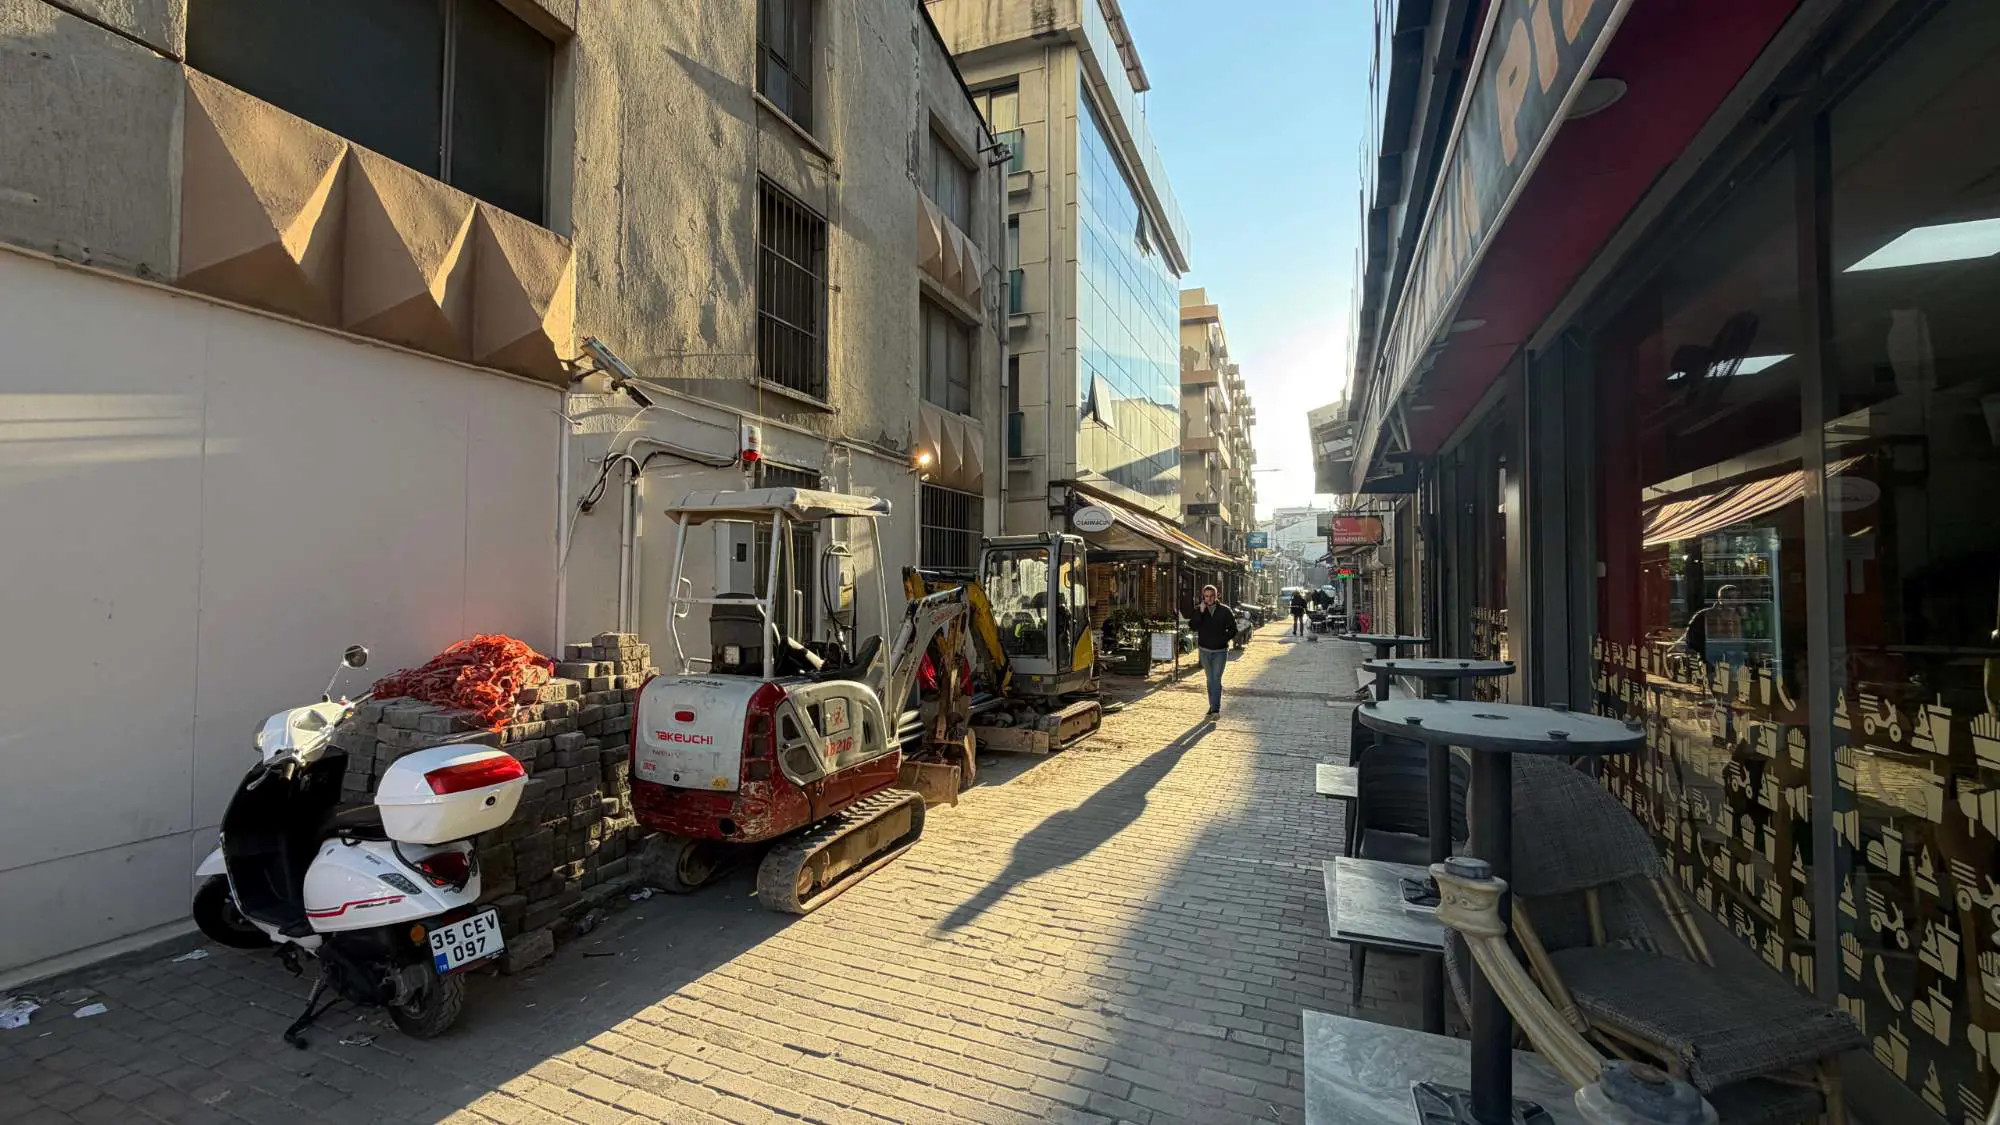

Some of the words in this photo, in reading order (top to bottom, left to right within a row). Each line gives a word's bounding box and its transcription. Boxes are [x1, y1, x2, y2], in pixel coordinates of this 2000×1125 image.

[656, 731, 713, 745] TAKEUCHI
[432, 928, 456, 950] 35
[462, 914, 495, 939] CEV
[453, 936, 486, 961] 097
